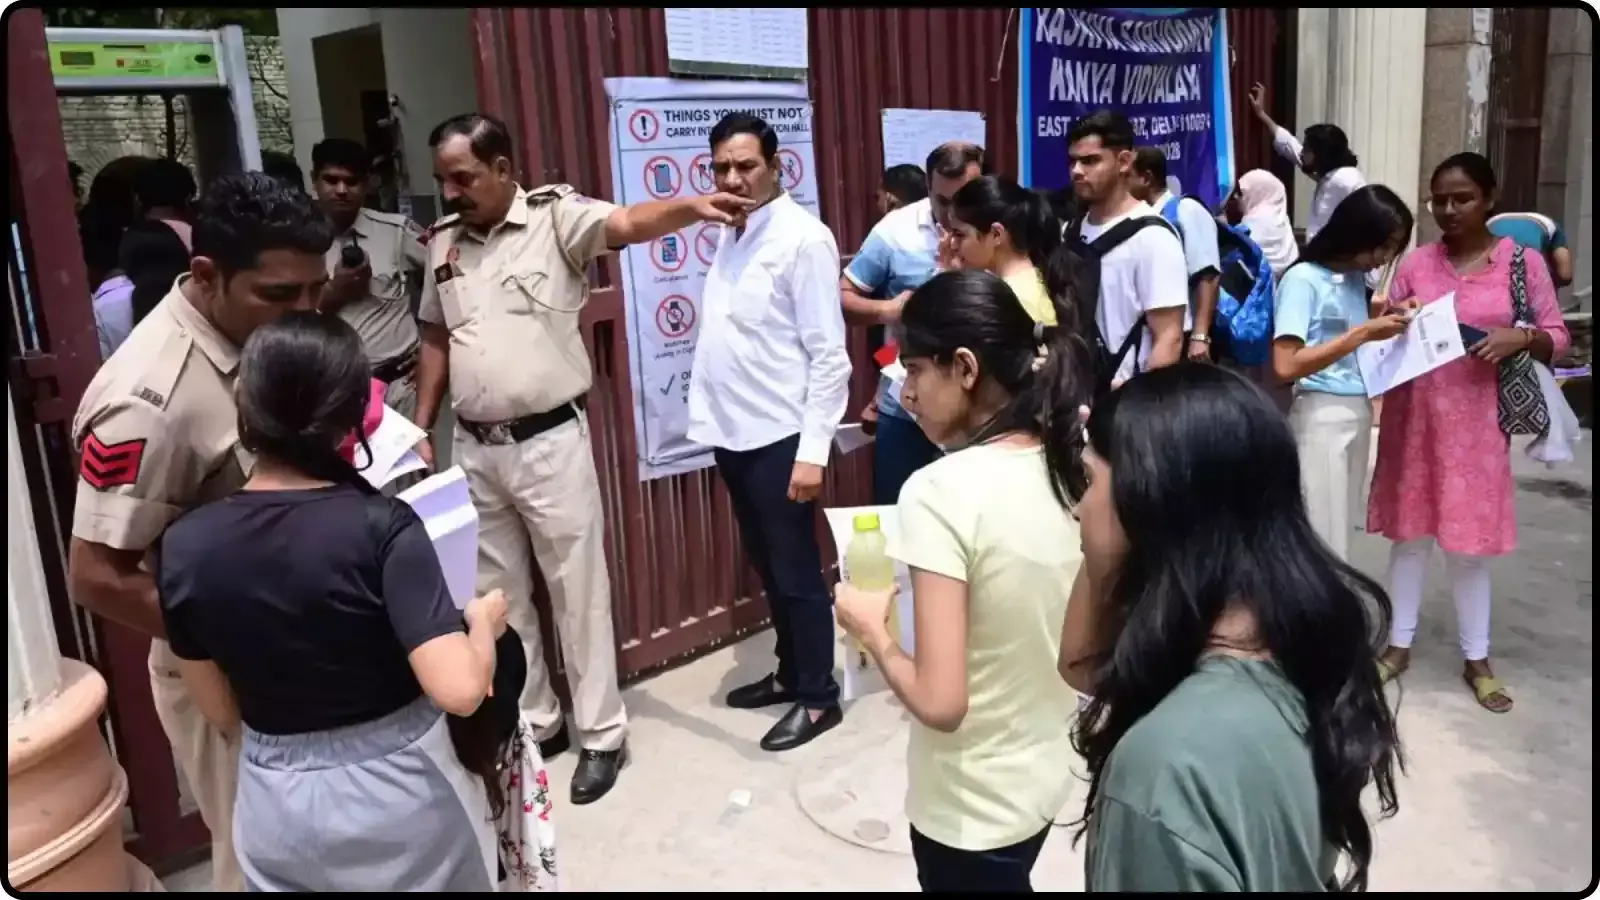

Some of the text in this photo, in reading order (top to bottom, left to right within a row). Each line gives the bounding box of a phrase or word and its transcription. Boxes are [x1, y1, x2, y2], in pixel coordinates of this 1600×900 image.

[664, 109, 710, 122] THINGS
[778, 107, 804, 118] NOT
[666, 126, 696, 138] CARRY
[791, 122, 809, 132] HALL
[1037, 115, 1071, 137] EAST
